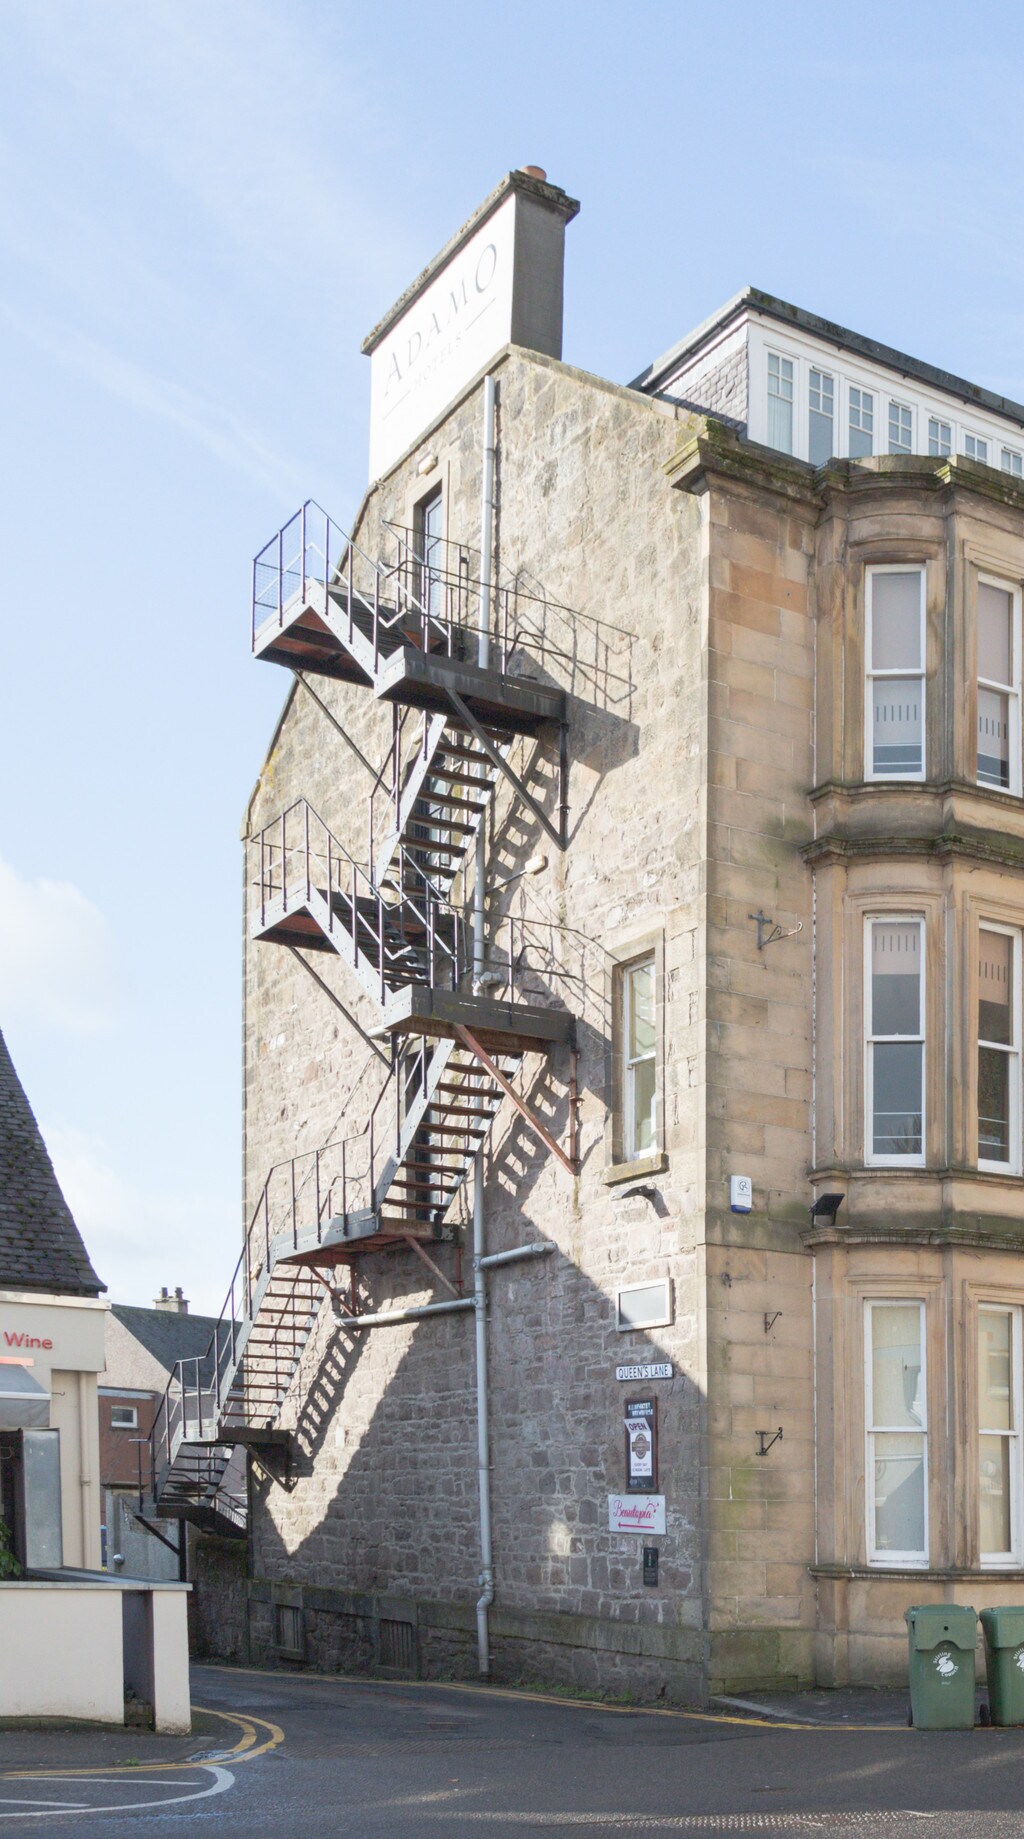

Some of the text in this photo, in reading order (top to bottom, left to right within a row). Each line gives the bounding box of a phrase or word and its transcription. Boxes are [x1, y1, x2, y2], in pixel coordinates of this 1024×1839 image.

[383, 243, 498, 398] ADAMO
[412, 331, 462, 391] HOTELS
[3, 1331, 53, 1350] Wine
[618, 1364, 669, 1379] QUEEN'S LANE
[628, 1422, 648, 1431] OPEN
[613, 1499, 655, 1524] Beautopia
